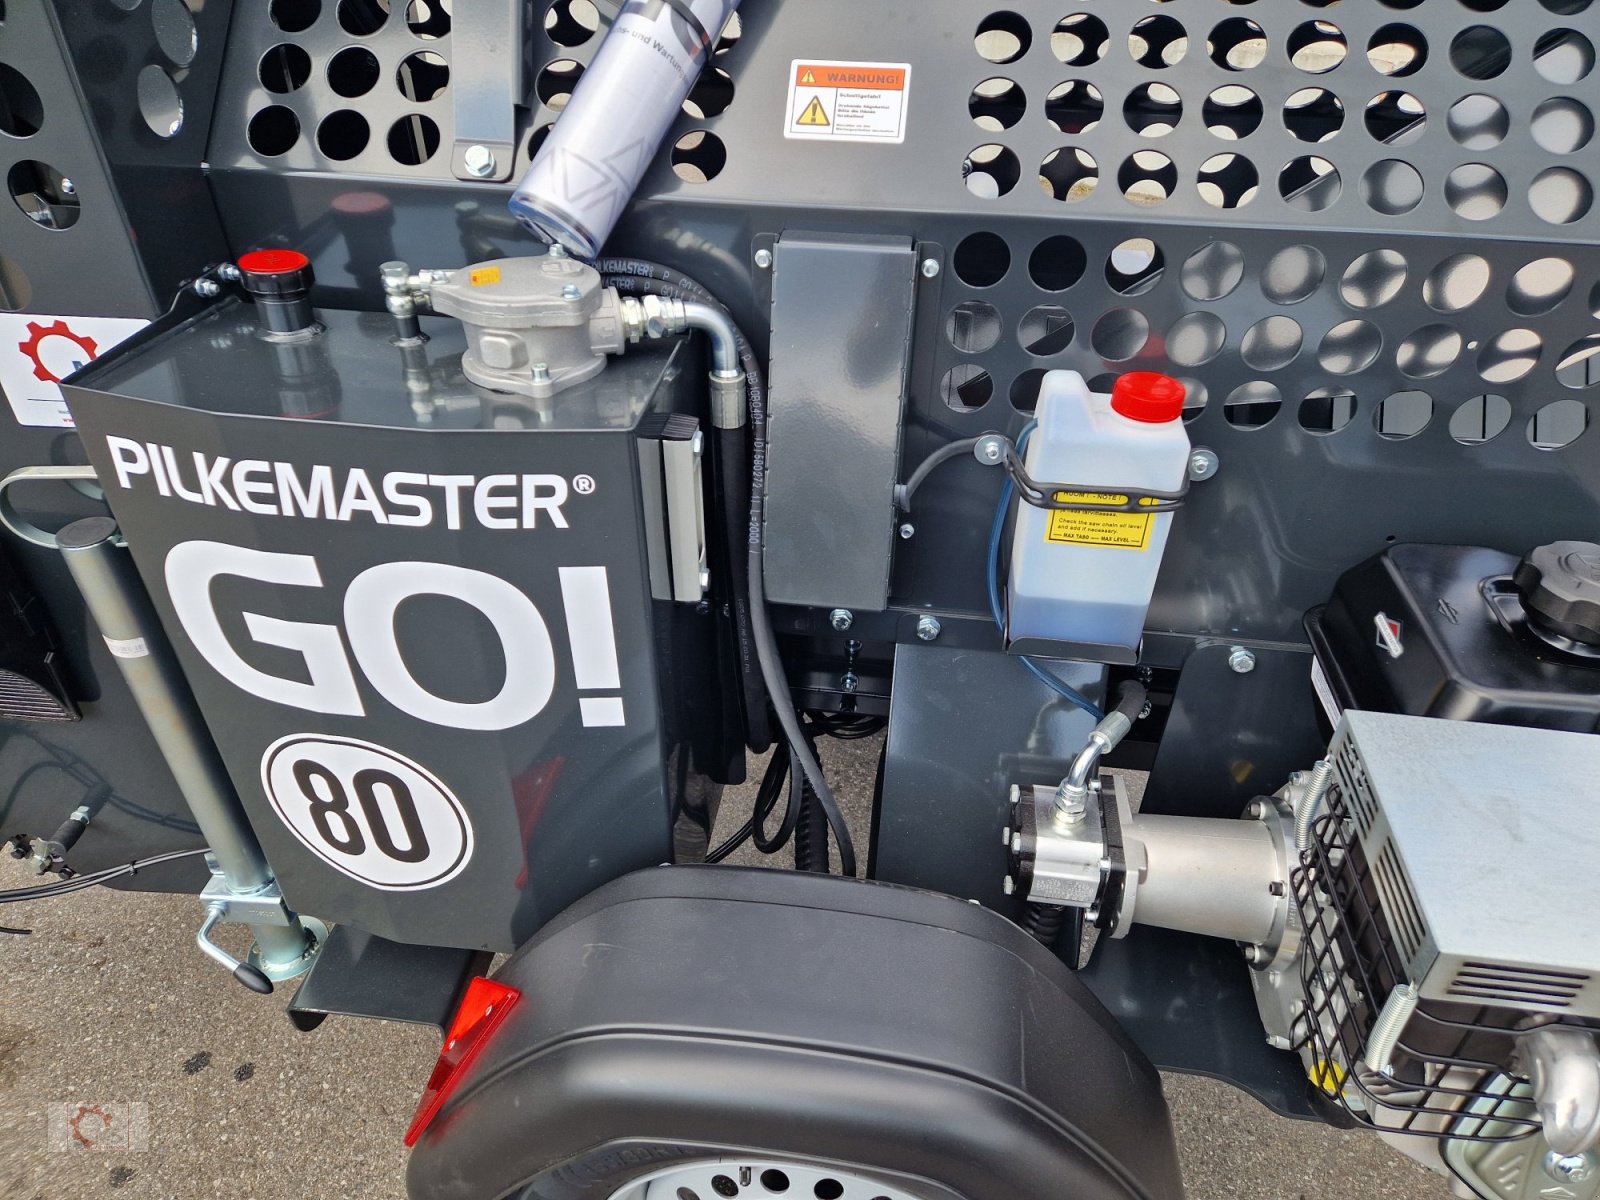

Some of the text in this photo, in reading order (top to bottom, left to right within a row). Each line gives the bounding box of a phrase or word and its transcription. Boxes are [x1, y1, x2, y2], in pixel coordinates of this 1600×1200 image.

[632, 30, 652, 44] und
[827, 73, 899, 84] WARNUNG!
[164, 540, 627, 732] GO!
[292, 758, 431, 864] 80
